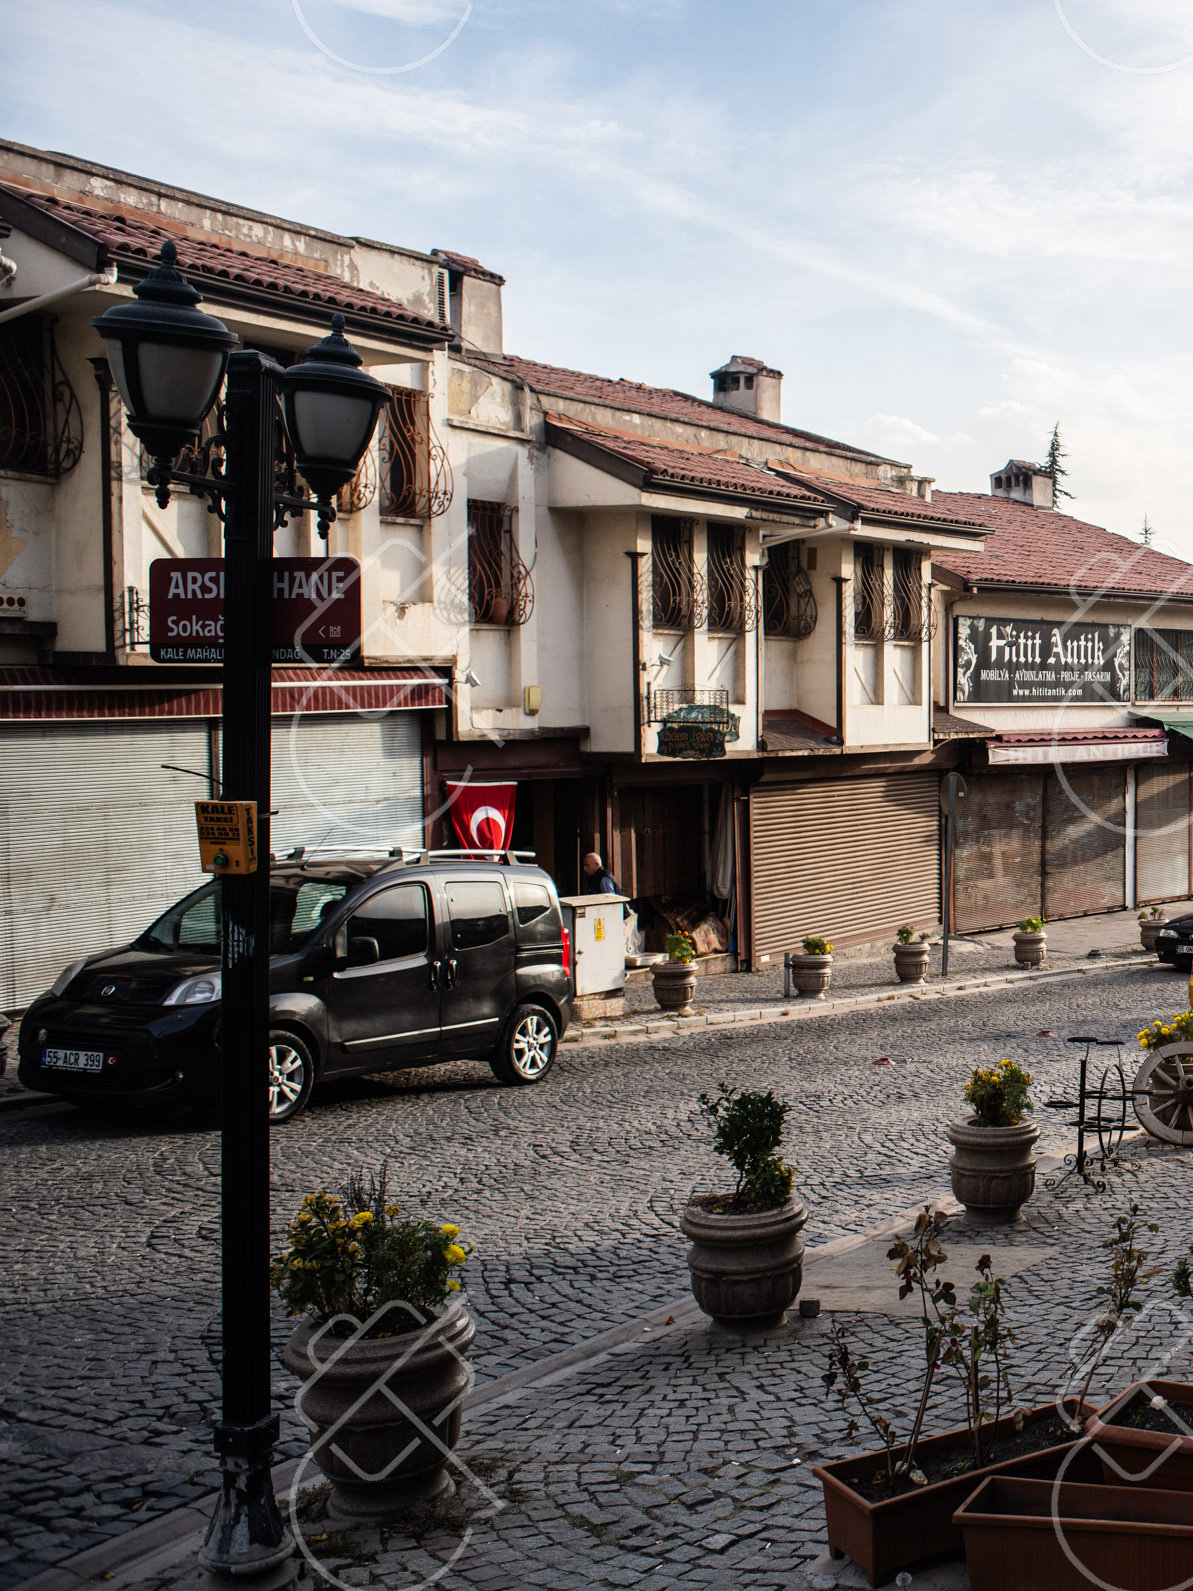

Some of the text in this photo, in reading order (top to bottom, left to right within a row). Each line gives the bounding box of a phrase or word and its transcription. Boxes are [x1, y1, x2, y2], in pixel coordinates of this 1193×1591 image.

[989, 623, 1105, 666] Hitit Antik
[160, 648, 184, 660] KALE
[980, 668, 1010, 681] MOBİLYA
[1015, 669, 1056, 682] AYDINLATMA
[1061, 671, 1080, 682] PROJE
[1084, 671, 1111, 682] TASARIM
[1012, 687, 1083, 697] www.hititantik.com
[200, 805, 235, 815] KALE
[47, 1050, 101, 1068] 55 ACR 399
